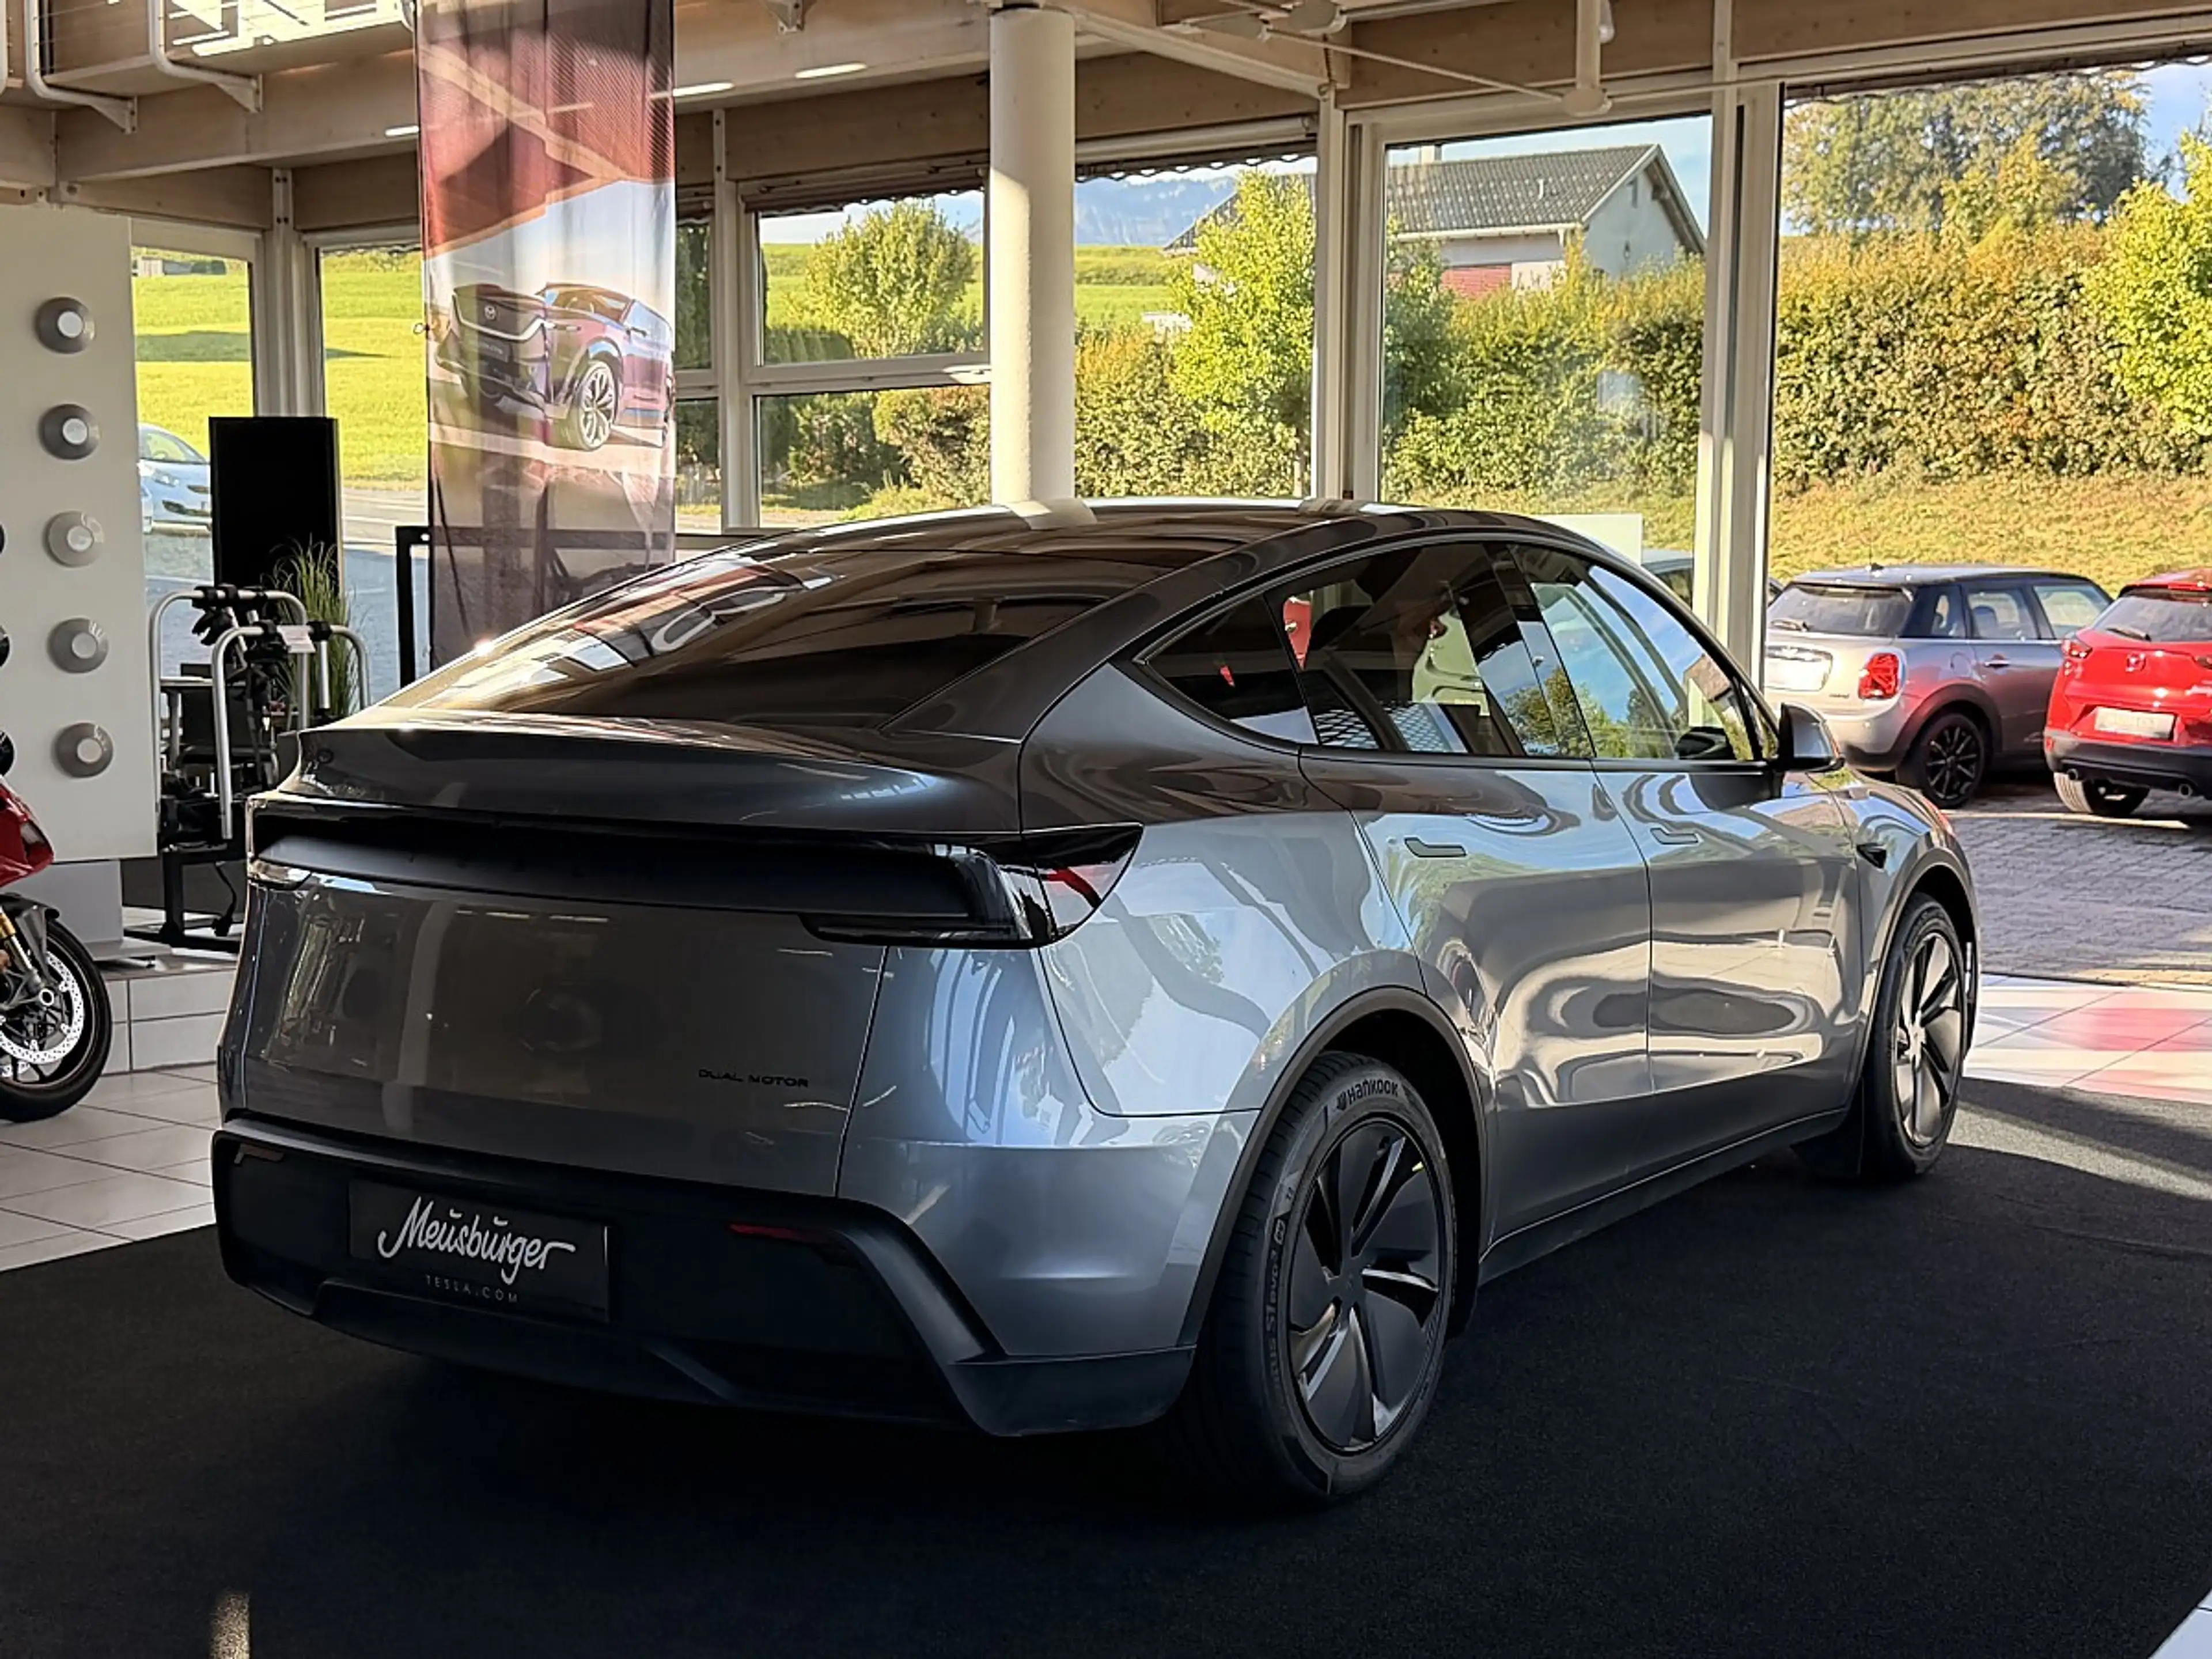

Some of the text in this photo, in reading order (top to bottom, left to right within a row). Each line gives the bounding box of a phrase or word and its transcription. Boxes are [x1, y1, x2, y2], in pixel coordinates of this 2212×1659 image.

[698, 1069, 809, 1088] DUAL MOTOR
[425, 1274, 518, 1304] TESLA.COM
